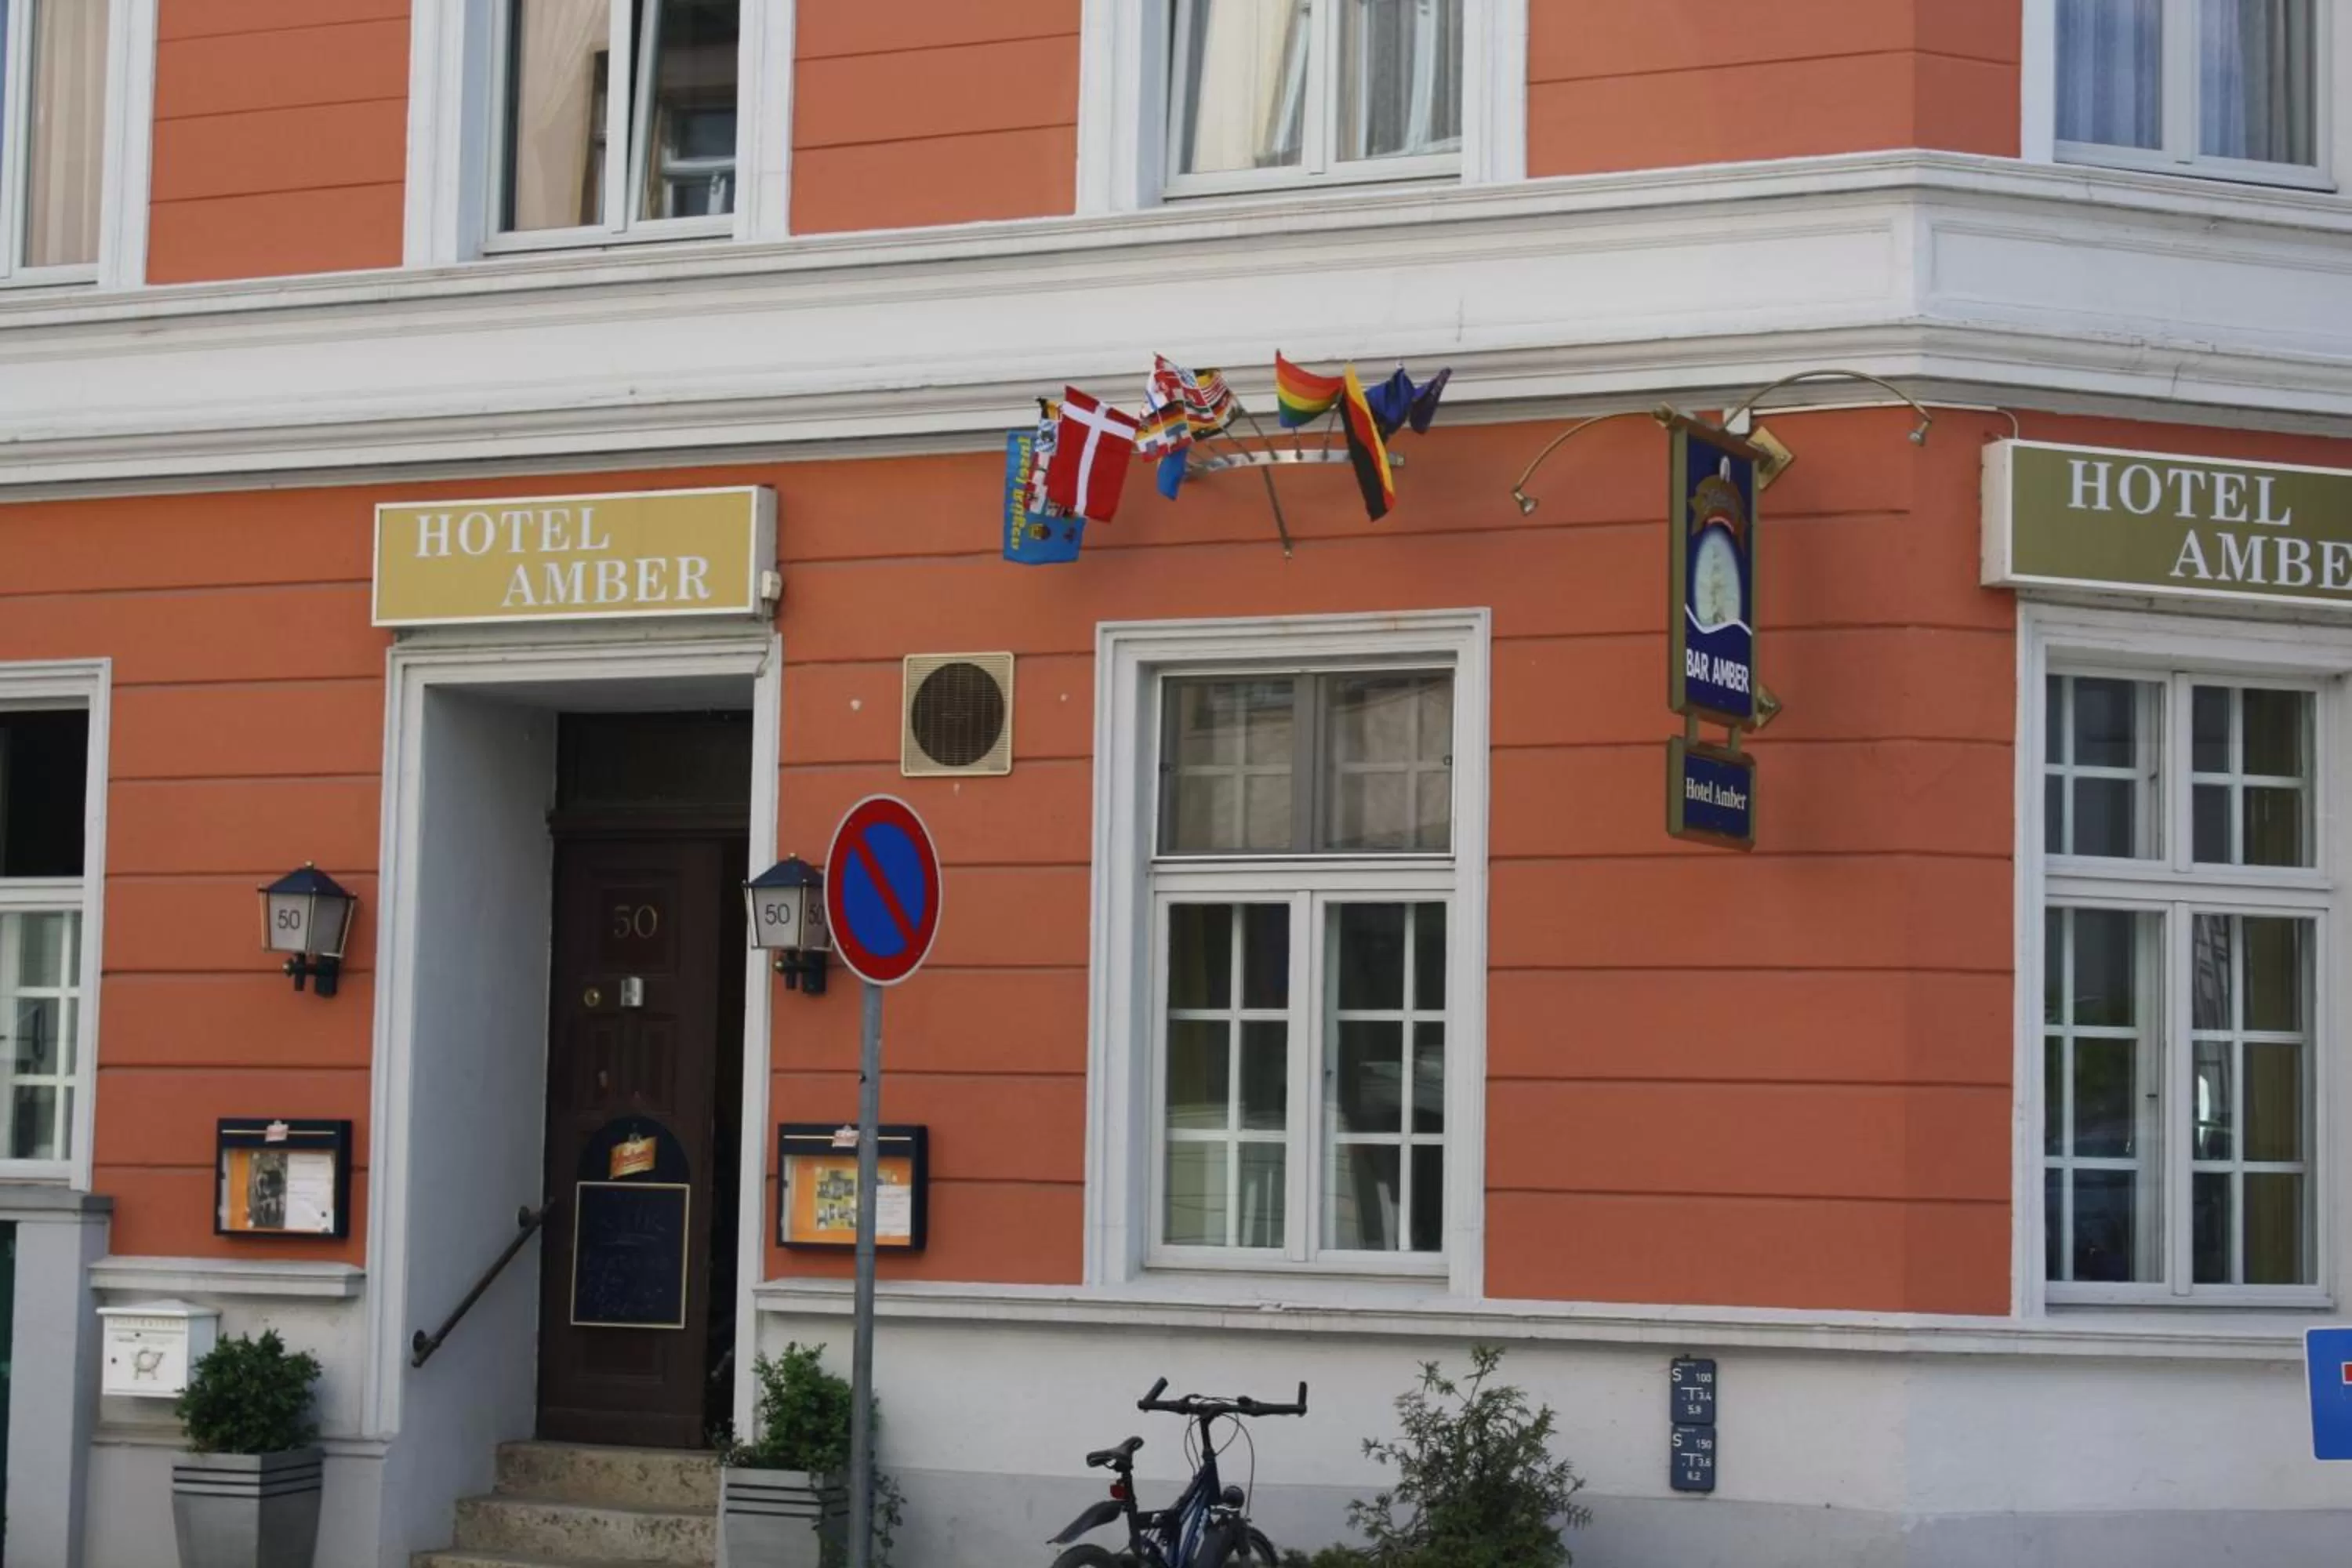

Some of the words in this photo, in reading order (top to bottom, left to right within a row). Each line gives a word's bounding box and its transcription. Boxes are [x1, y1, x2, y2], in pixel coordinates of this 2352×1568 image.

[2067, 459, 2292, 526] HOTEL
[416, 507, 610, 557] HOTEL
[501, 556, 712, 607] AMBER
[1686, 648, 1710, 682] BAR
[1711, 655, 1750, 694] AMBER
[1686, 777, 1713, 804] Hotel
[1714, 784, 1747, 810] Amber
[278, 909, 301, 930] 50
[613, 904, 658, 938] 50
[764, 903, 791, 925] 50
[1672, 1367, 1682, 1382] S
[1695, 1373, 1712, 1383] 100
[1672, 1433, 1682, 1447] S
[1696, 1439, 1712, 1450] 150
